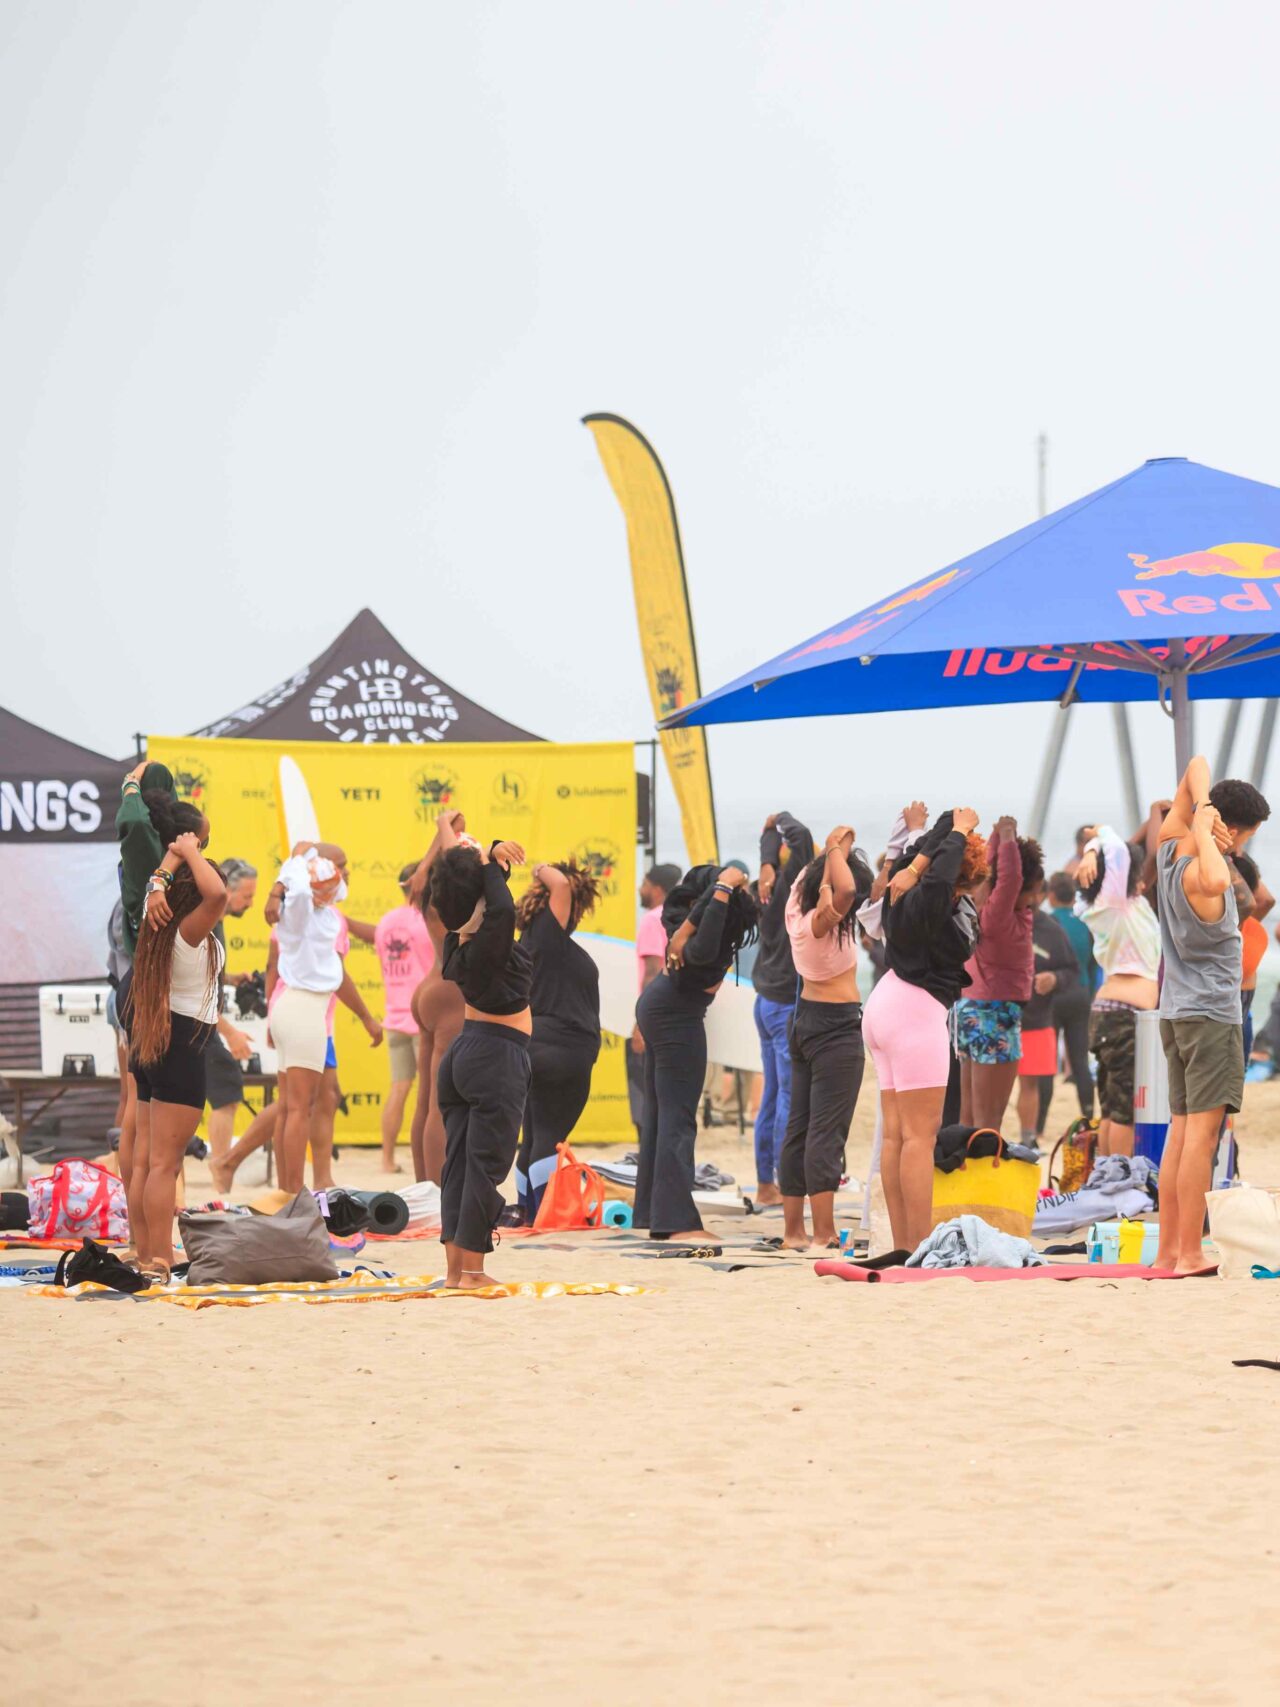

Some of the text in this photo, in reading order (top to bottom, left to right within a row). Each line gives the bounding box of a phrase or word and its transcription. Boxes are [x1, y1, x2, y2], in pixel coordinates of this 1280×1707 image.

[1117, 582, 1273, 617] Red
[341, 788, 381, 800] YETI
[346, 1093, 381, 1104] ETI
